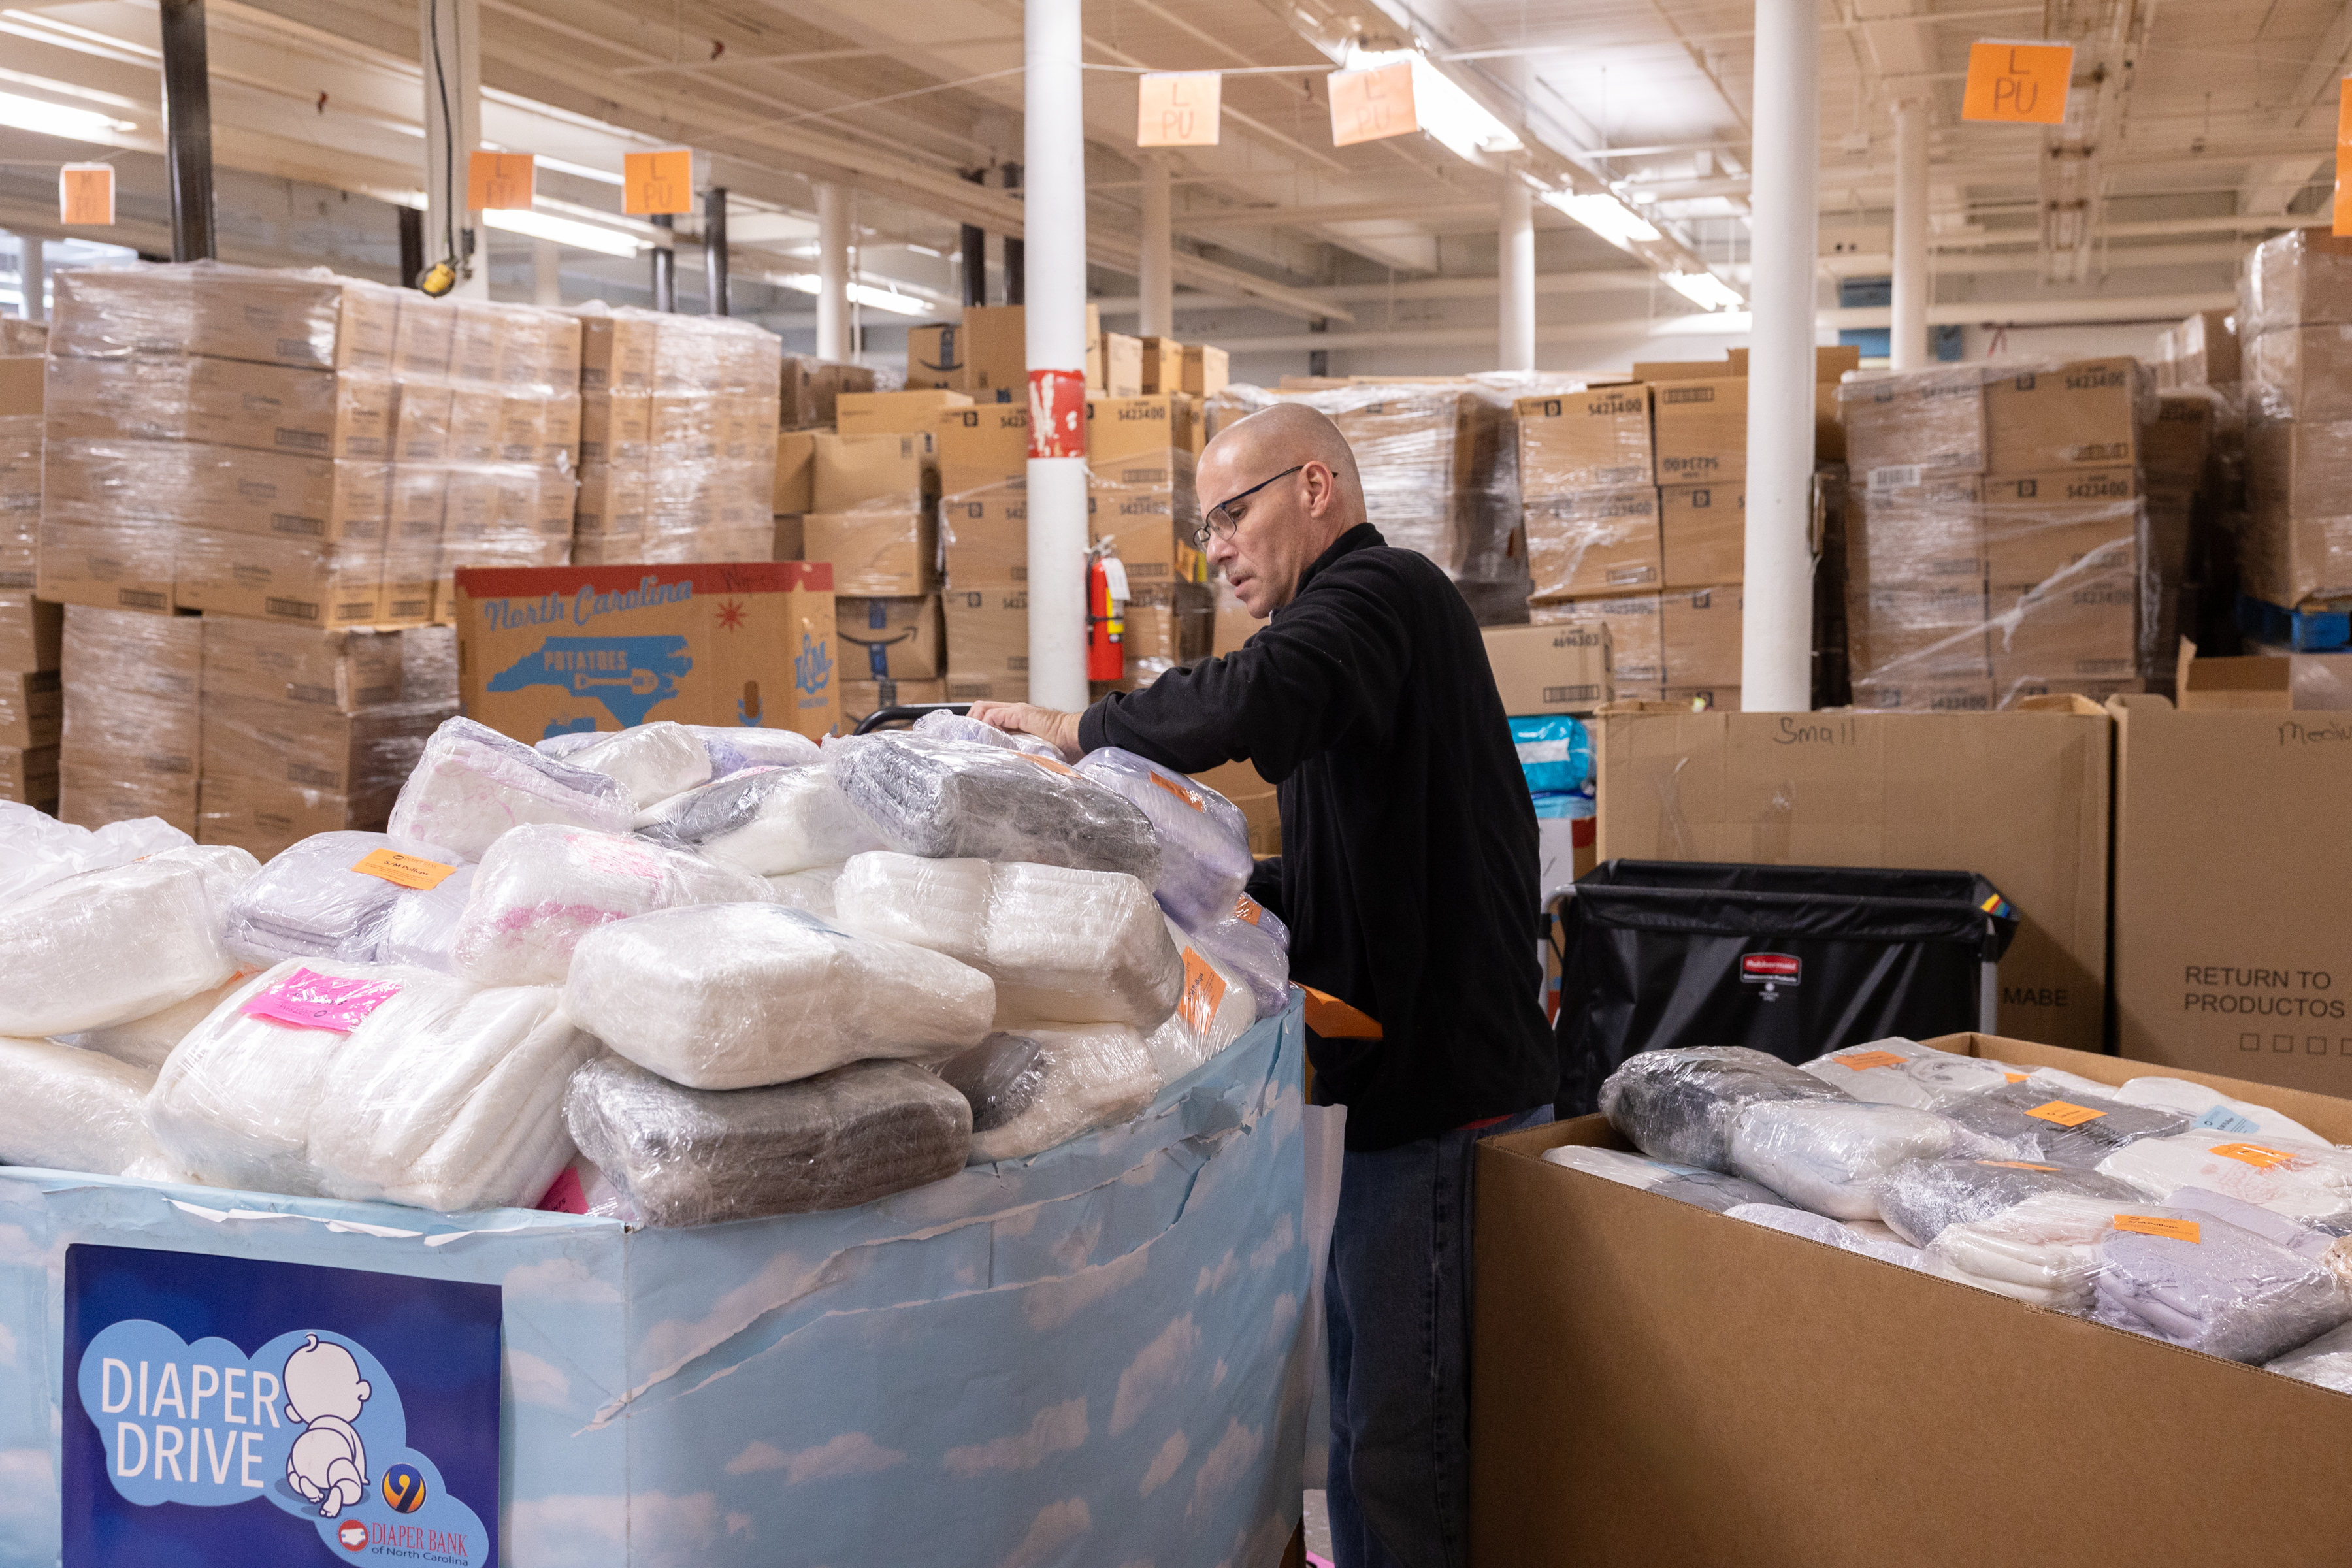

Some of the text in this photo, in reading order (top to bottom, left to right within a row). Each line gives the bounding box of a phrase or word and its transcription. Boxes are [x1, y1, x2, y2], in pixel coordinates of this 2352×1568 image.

[2009, 48, 2030, 74] L
[1172, 82, 1189, 107] L
[1365, 75, 1386, 101] L
[1994, 77, 2038, 115] PU
[1162, 109, 1194, 140] PU
[1355, 105, 1392, 137] PU
[495, 154, 510, 179] L
[650, 156, 666, 181] L
[644, 182, 673, 209] PU
[1118, 406, 1166, 421] 5423400
[1588, 398, 1642, 416] 5423400
[1663, 457, 1718, 472] 5423400
[2066, 480, 2129, 499] 5423400
[484, 591, 565, 632] North
[572, 576, 693, 626] Carolina
[543, 651, 628, 672] POTATOES
[1773, 716, 1855, 745] Small
[402, 865, 429, 875] Pullups
[2185, 966, 2331, 990] RETURN TO
[2002, 986, 2068, 1007] MABE
[2184, 992, 2344, 1019] PRODUCTOS
[100, 1356, 282, 1429] DIAPER
[116, 1420, 266, 1489] DRIVE
[388, 1463, 422, 1514] 9
[372, 1522, 468, 1557] DIAPER BANK
[387, 1547, 420, 1560] North
[423, 1552, 468, 1567] Carolina
